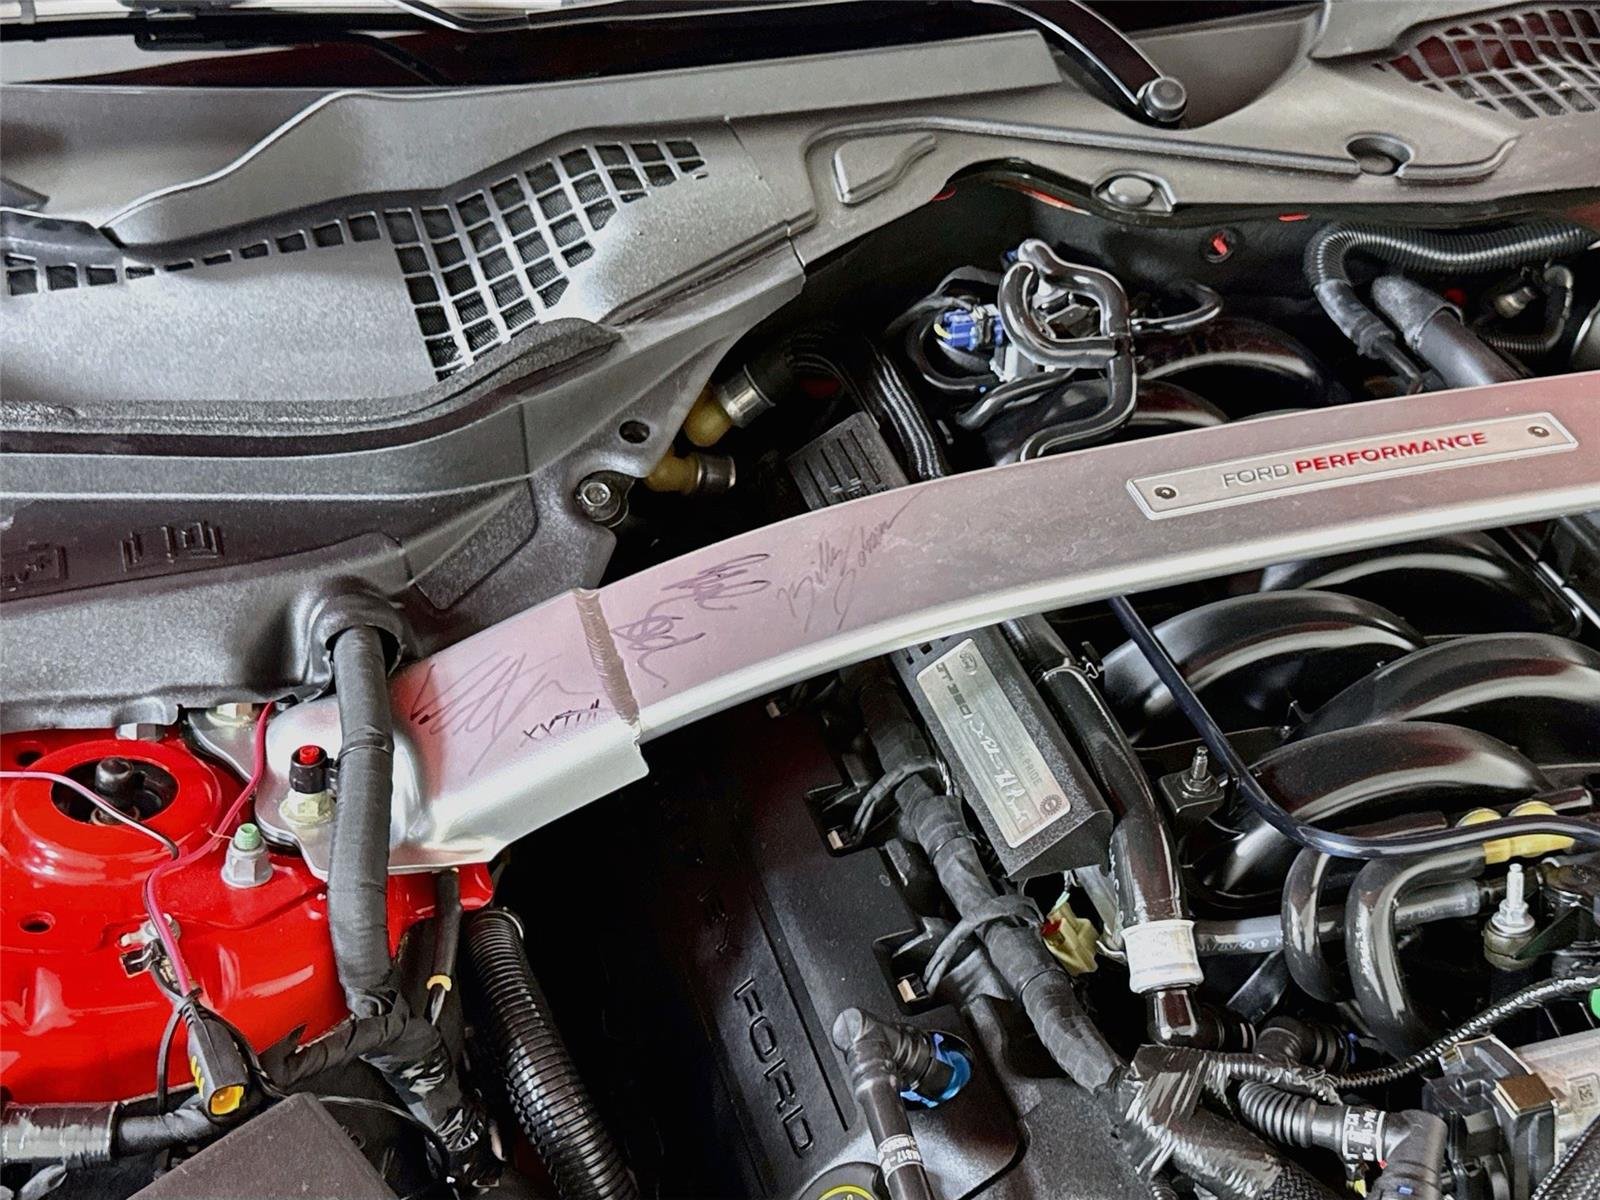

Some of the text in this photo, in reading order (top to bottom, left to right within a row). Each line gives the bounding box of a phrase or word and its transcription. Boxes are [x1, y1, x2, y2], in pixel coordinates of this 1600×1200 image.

[1221, 432, 1488, 488] FORD PERFORMANCE
[733, 977, 813, 1159] FORD
